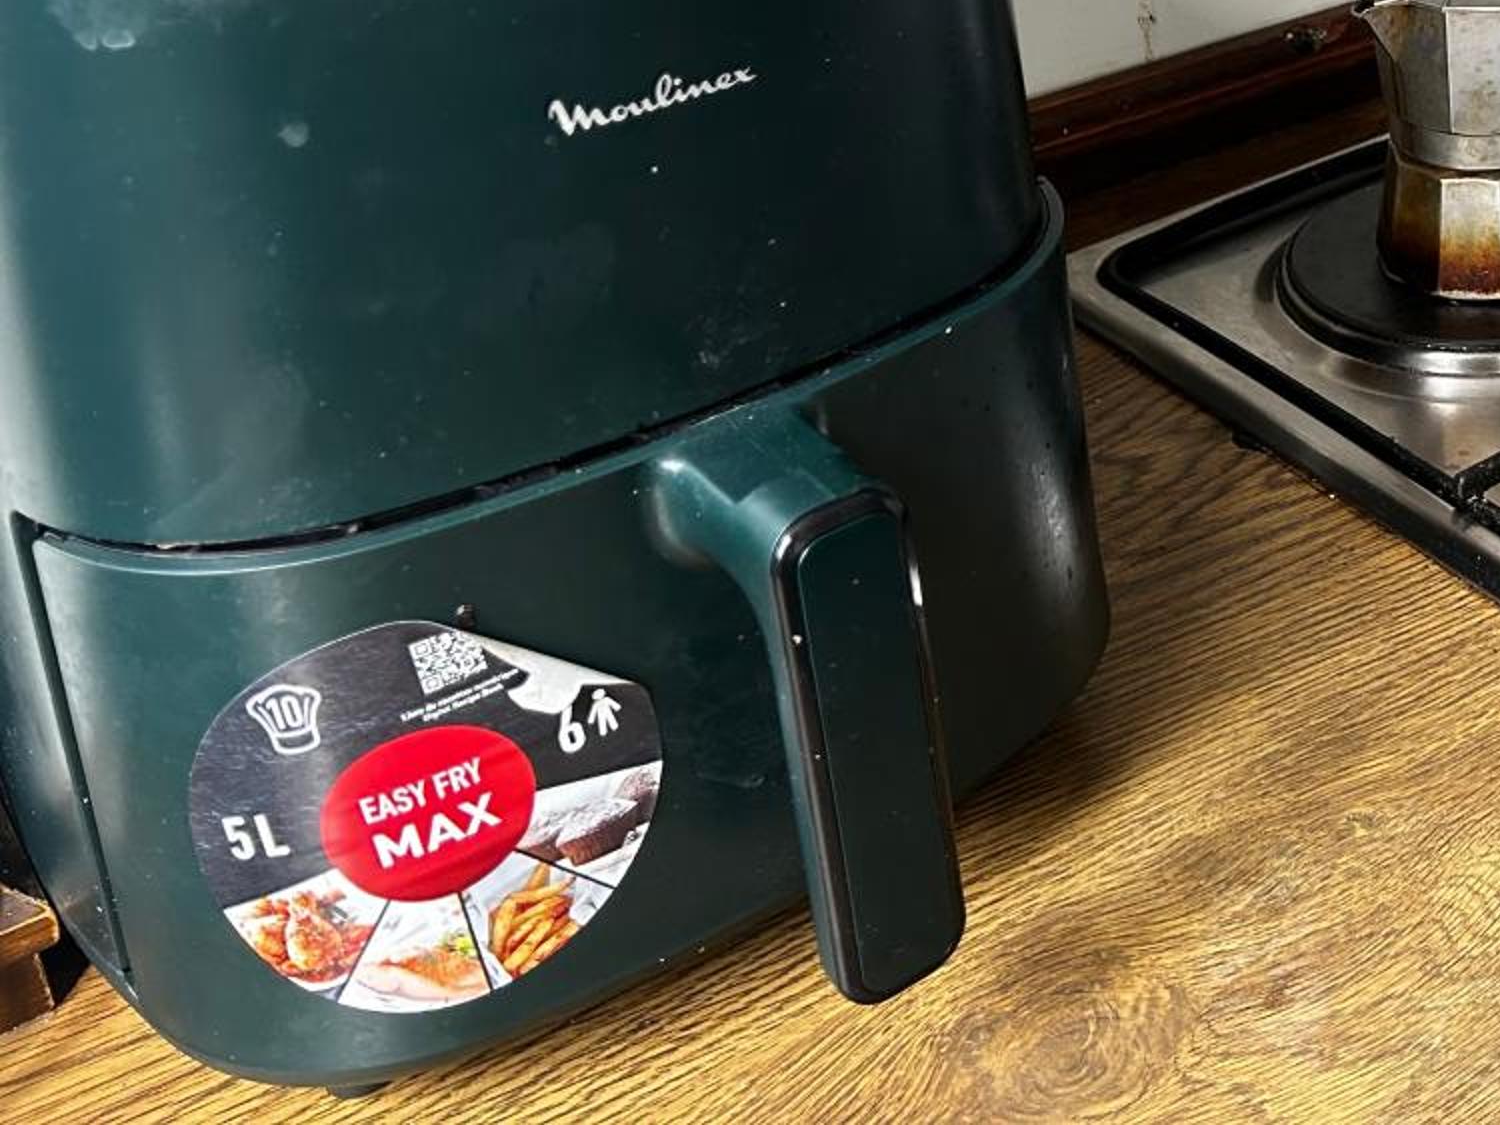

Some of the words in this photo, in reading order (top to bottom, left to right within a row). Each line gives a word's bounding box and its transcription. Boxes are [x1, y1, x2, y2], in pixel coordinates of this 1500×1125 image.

[547, 65, 758, 137] Moulinex
[264, 694, 301, 731] 10
[557, 703, 587, 754] 6
[358, 778, 427, 826] EASY
[432, 756, 483, 801] FRY
[371, 791, 502, 870] MAX
